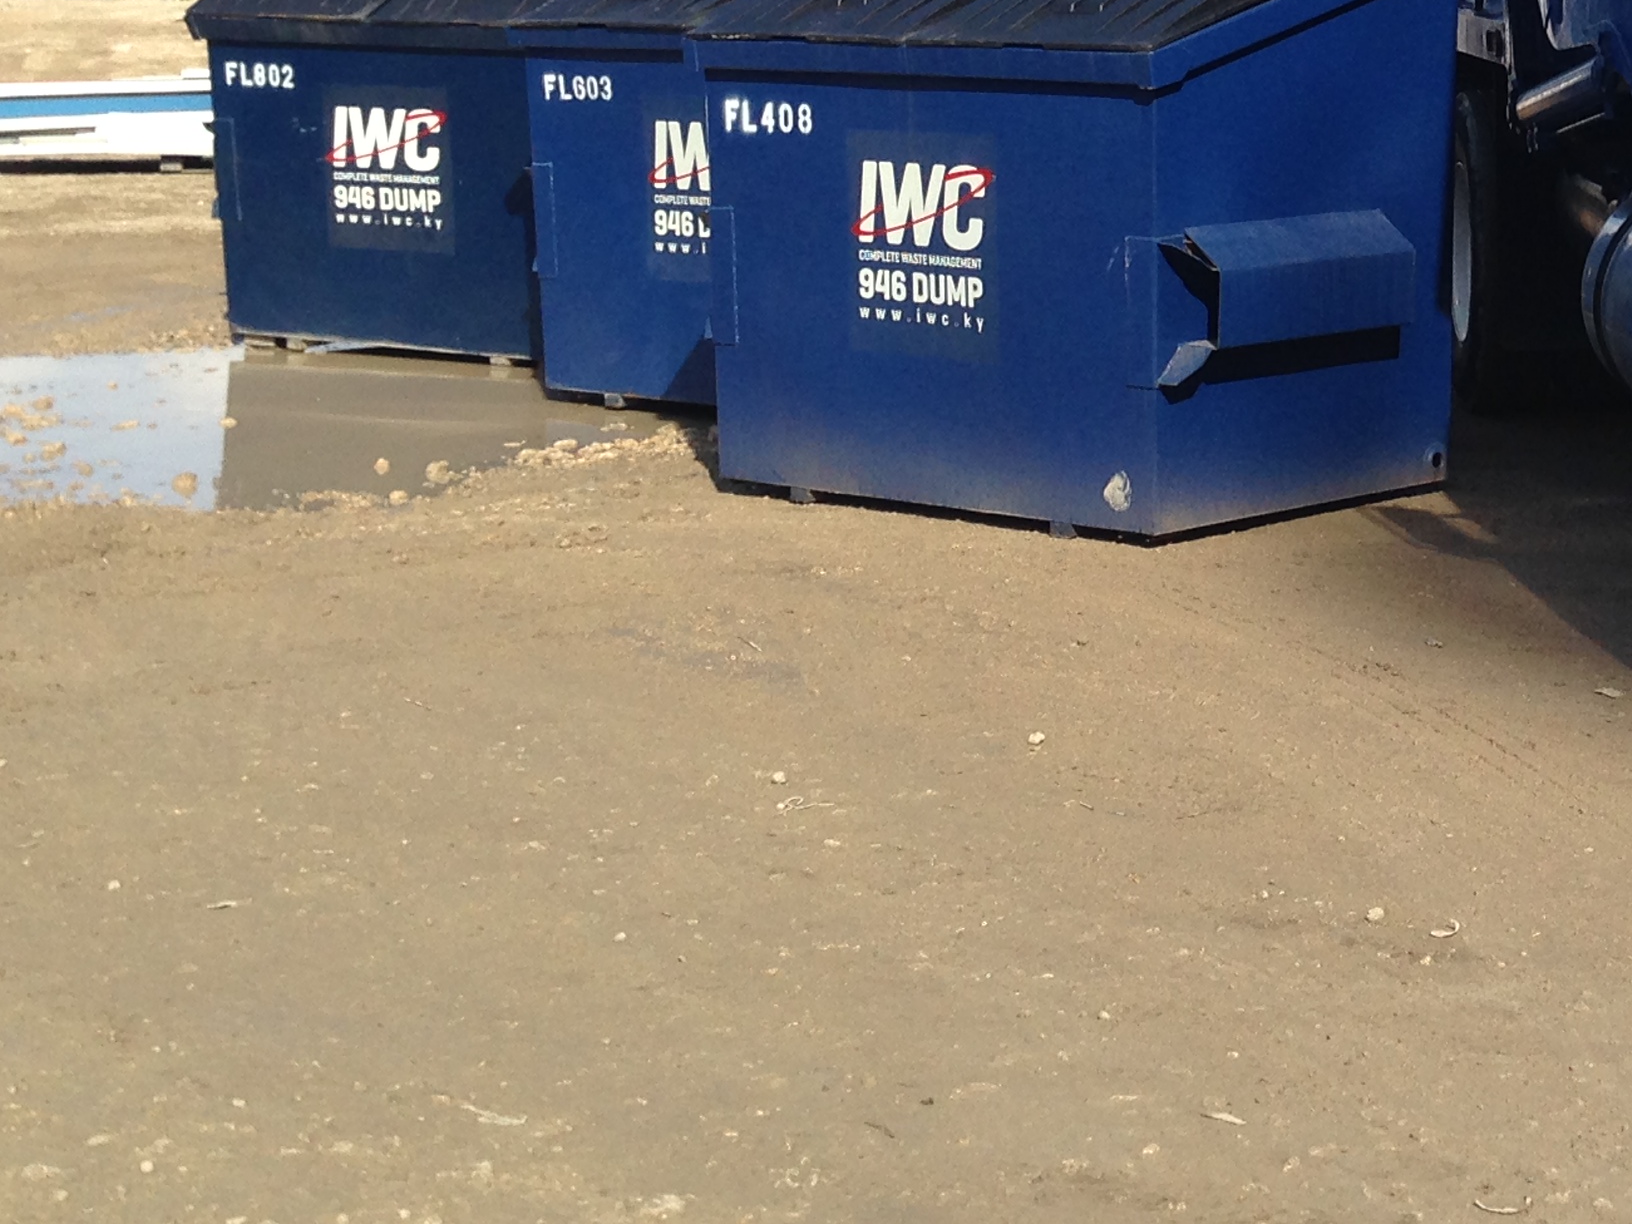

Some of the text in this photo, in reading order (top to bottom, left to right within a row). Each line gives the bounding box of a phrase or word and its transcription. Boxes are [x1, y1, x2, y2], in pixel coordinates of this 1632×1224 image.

[225, 61, 295, 89] FL802
[543, 73, 613, 101] FL603
[724, 98, 814, 134] FL408
[333, 105, 441, 172] IWC
[653, 120, 711, 192] IW
[334, 184, 442, 213] 946 DUMP
[857, 160, 986, 251] IWC
[654, 209, 694, 237] 946
[859, 249, 982, 270] COMPLETE WASTE MANAGEMENT
[859, 267, 983, 308] 946 DUMP
[859, 306, 984, 333] www.iwc.ky
